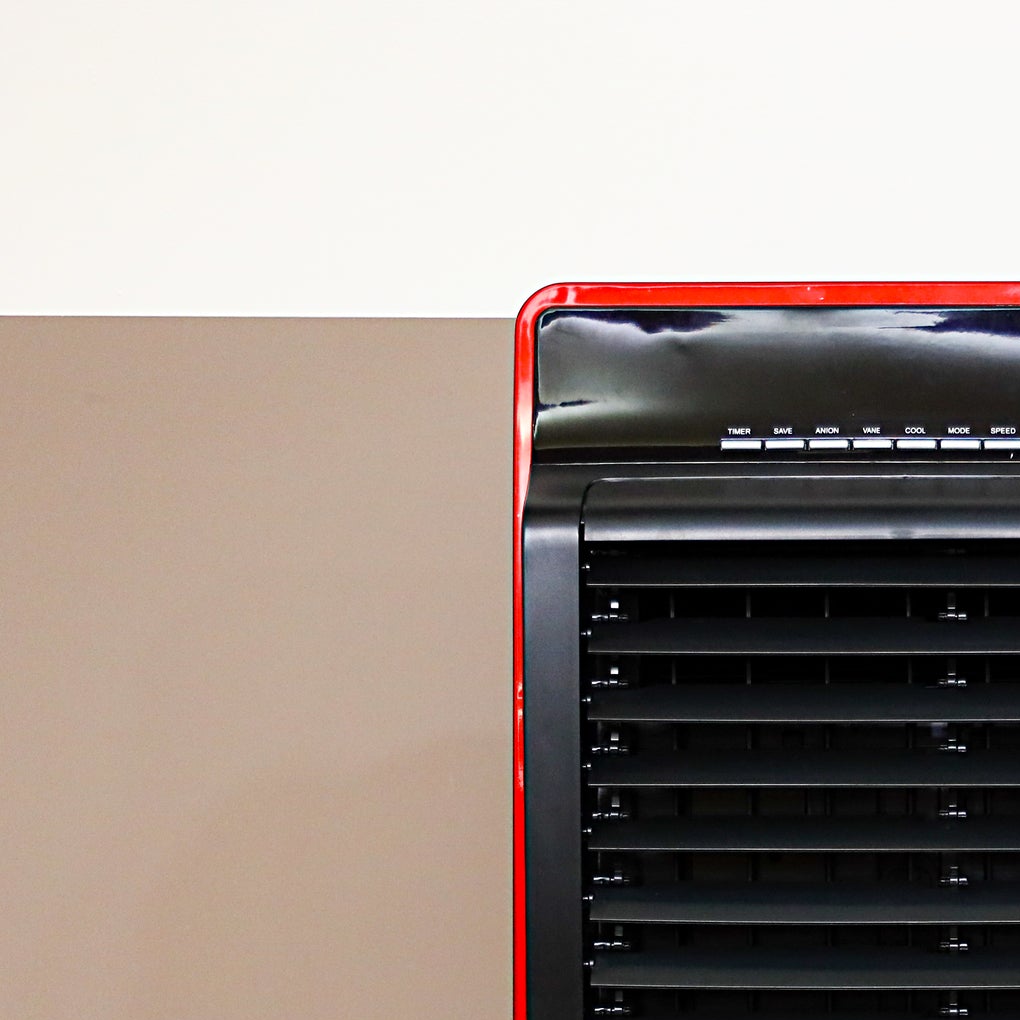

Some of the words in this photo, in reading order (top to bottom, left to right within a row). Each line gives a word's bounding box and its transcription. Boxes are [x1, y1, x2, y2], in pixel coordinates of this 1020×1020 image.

[773, 427, 793, 435] SAVE
[814, 427, 840, 435] ANION
[862, 427, 881, 435] VANE
[904, 427, 927, 435] COOL
[947, 427, 971, 435] MODE
[990, 427, 1017, 435] SPEED
